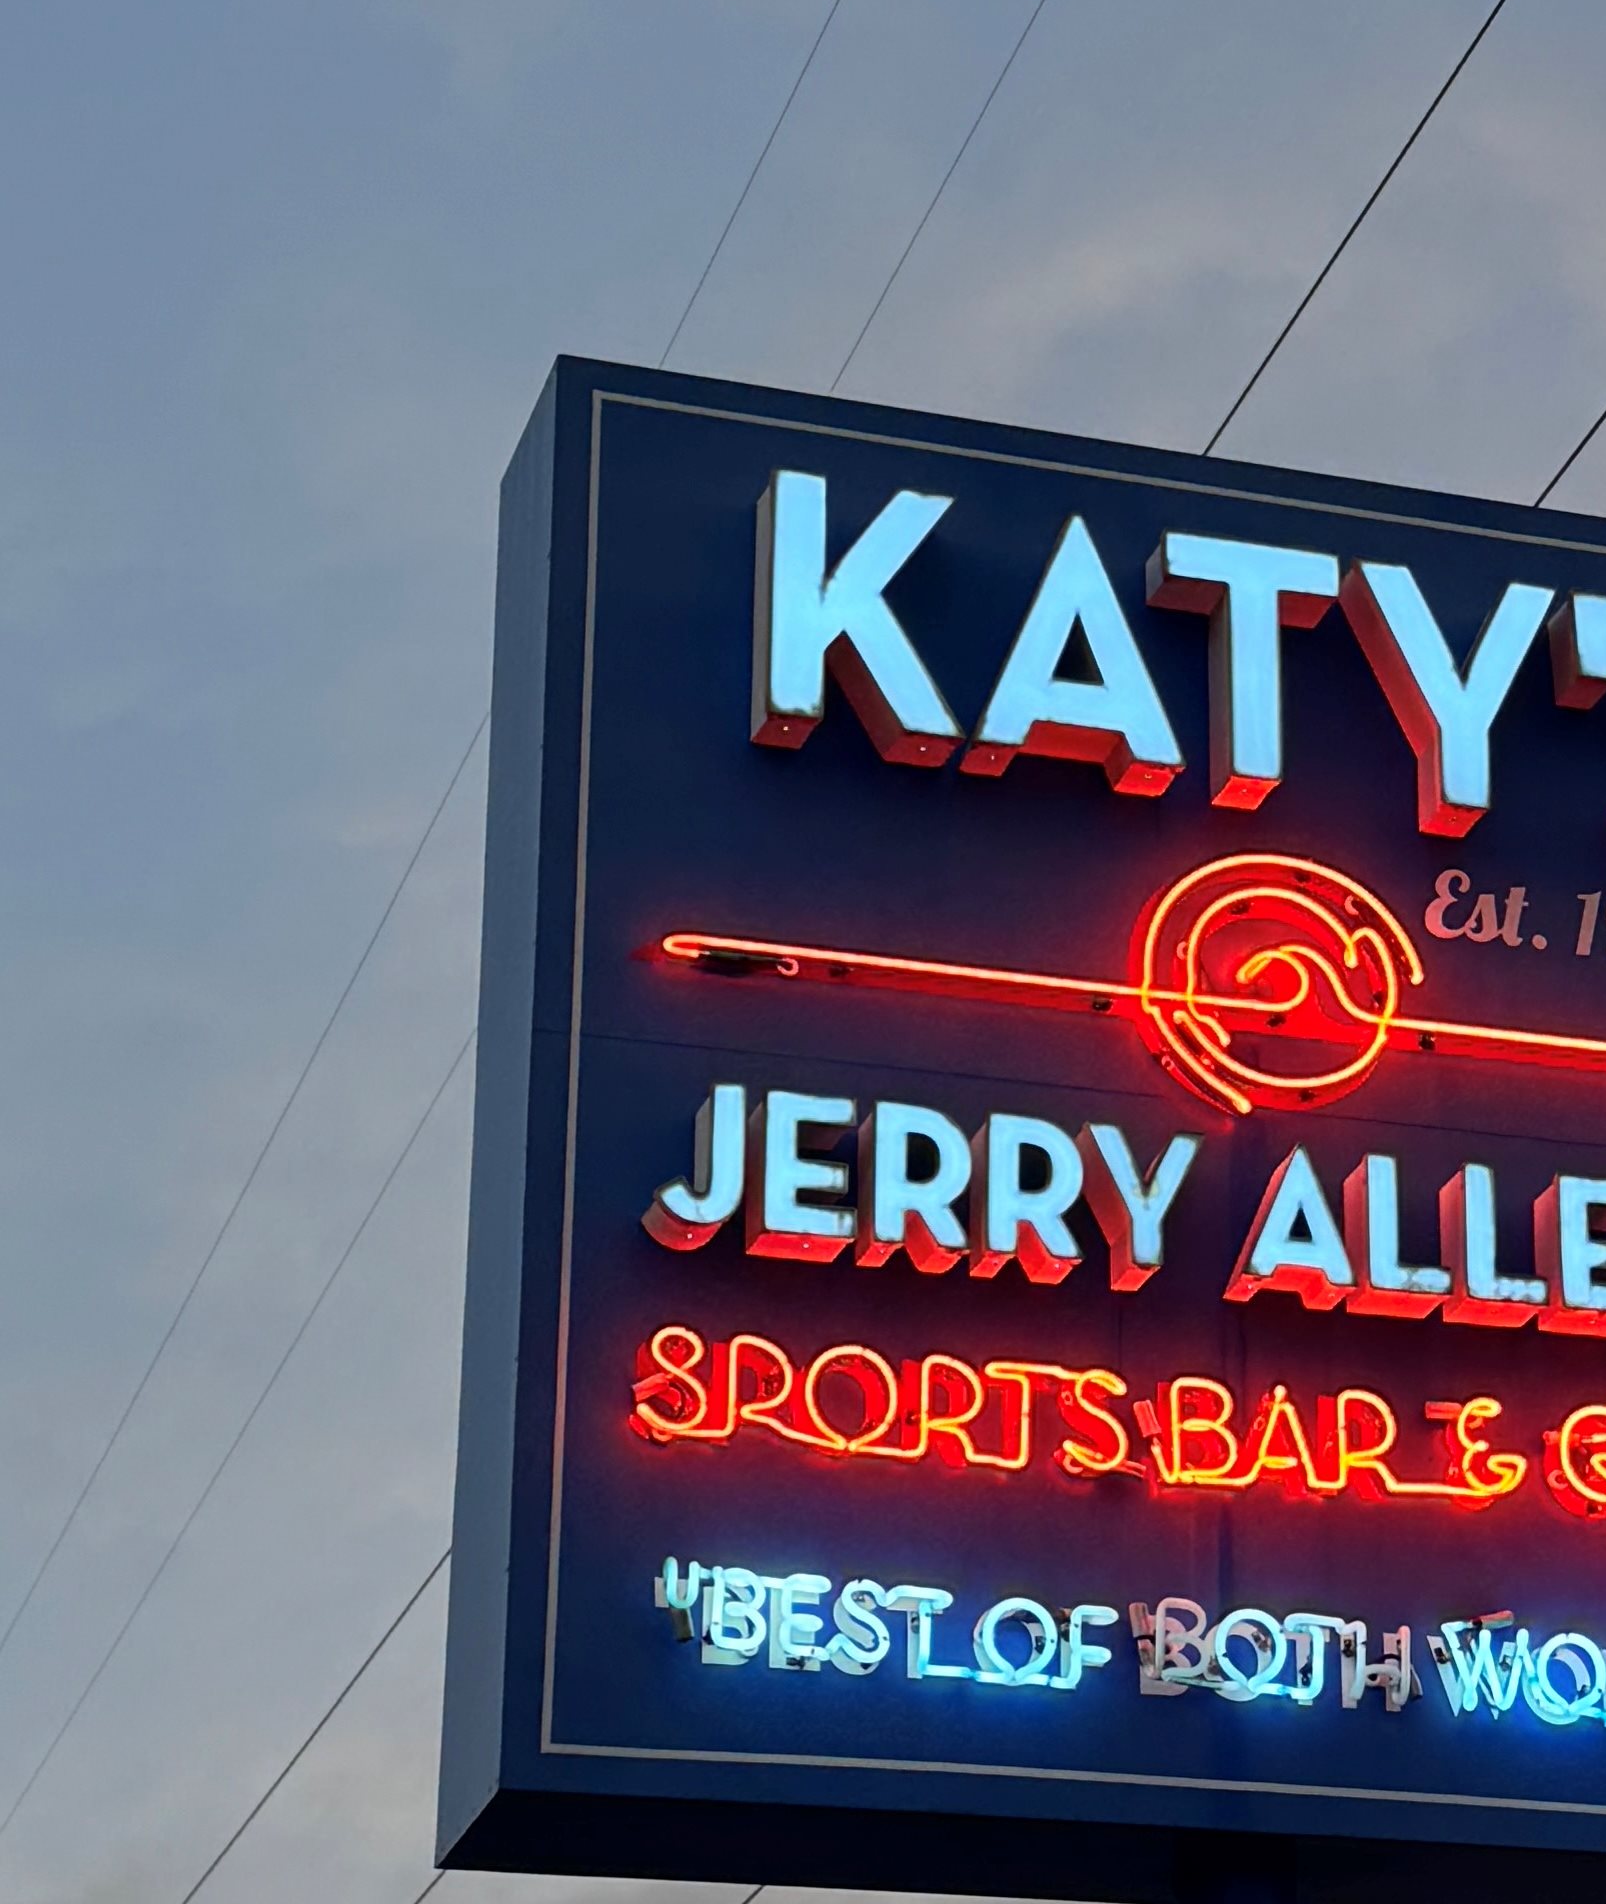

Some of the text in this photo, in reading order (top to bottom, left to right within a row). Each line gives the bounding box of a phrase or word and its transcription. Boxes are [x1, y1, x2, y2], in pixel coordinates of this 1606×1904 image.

[1424, 868, 1548, 950] Est.
[652, 1082, 1203, 1281] JERRY
[628, 1325, 1130, 1476] SPORTS
[1156, 1376, 1400, 1492] BAR
[1452, 1396, 1526, 1493] &
[978, 1596, 1119, 1690] OF
[1142, 1596, 1415, 1704] BOTH
